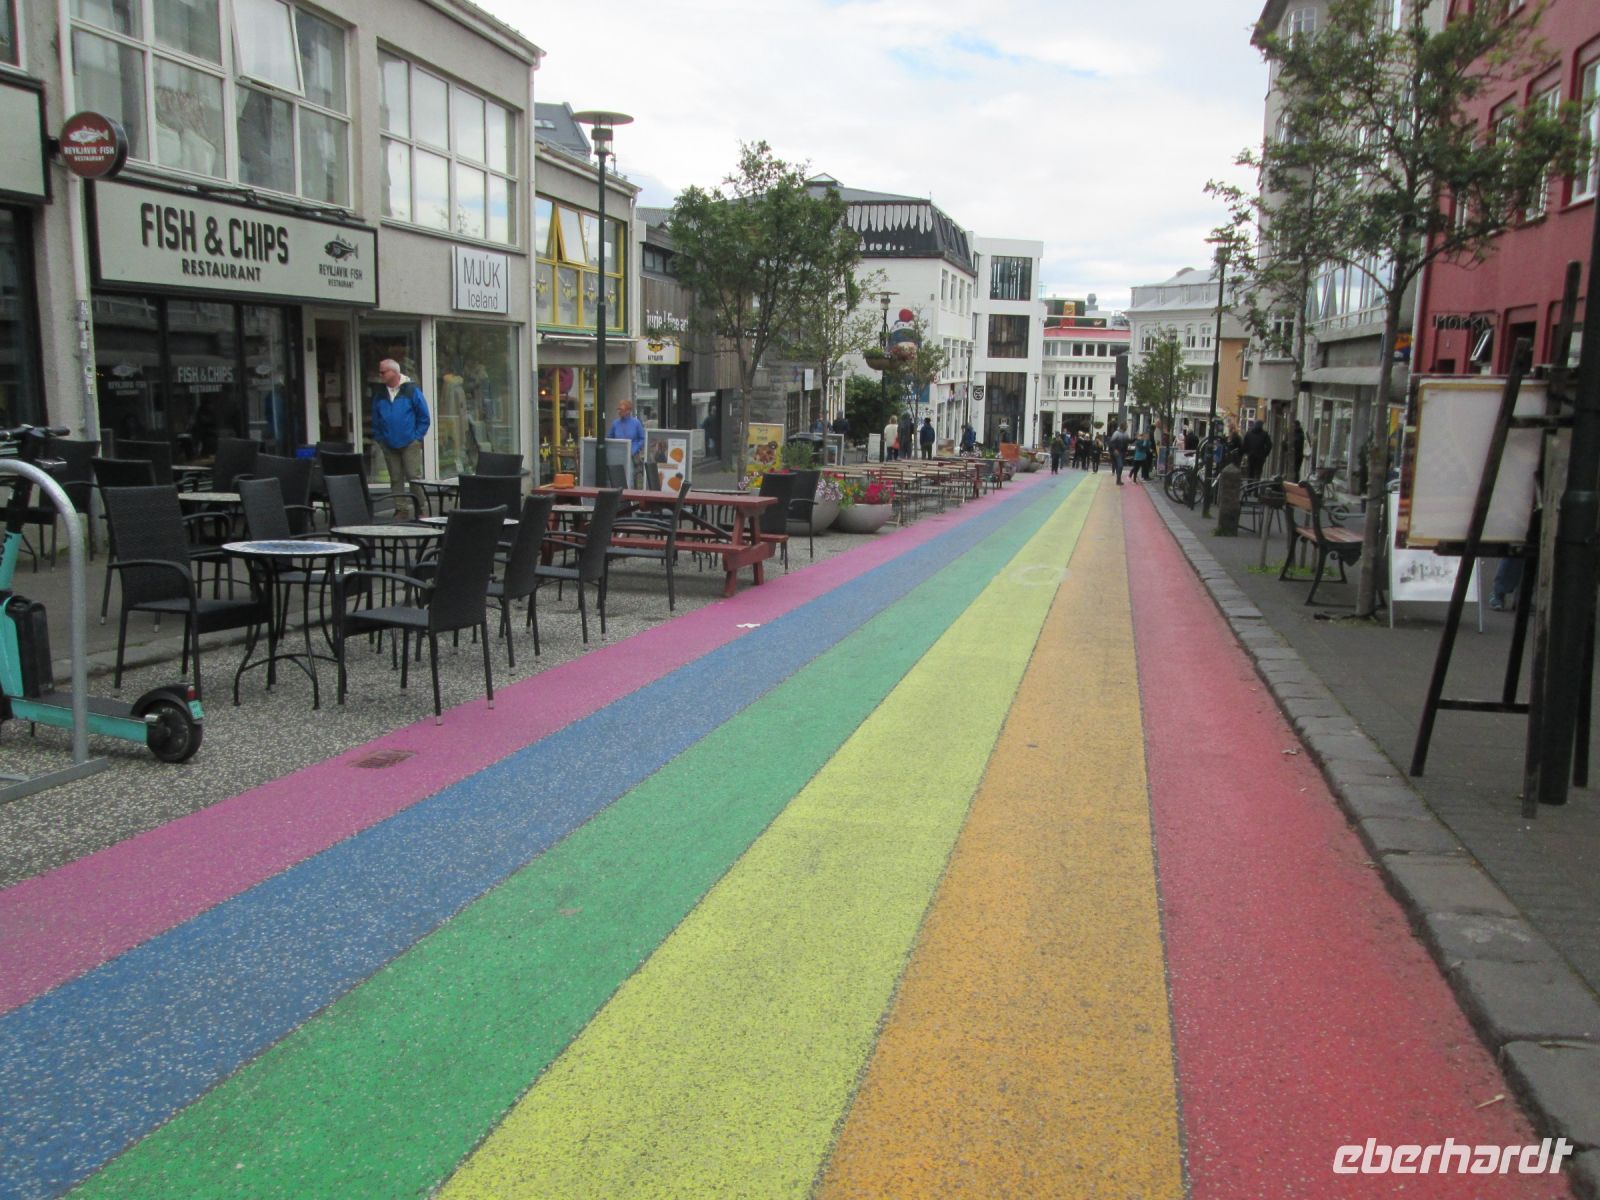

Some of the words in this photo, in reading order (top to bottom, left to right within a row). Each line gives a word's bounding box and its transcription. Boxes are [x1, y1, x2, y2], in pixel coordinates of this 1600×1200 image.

[100, 146, 115, 155] FISH
[140, 202, 197, 253] FISH
[204, 216, 225, 257] &
[229, 217, 289, 265] CHIPS
[181, 258, 262, 282] RESTAURANT
[318, 263, 348, 279] REYKJAVIK
[350, 268, 363, 281] FISH
[463, 254, 501, 289] MJÚK
[467, 289, 498, 310] Iceland
[178, 366, 200, 384] FISH
[208, 366, 234, 383] CHIPS
